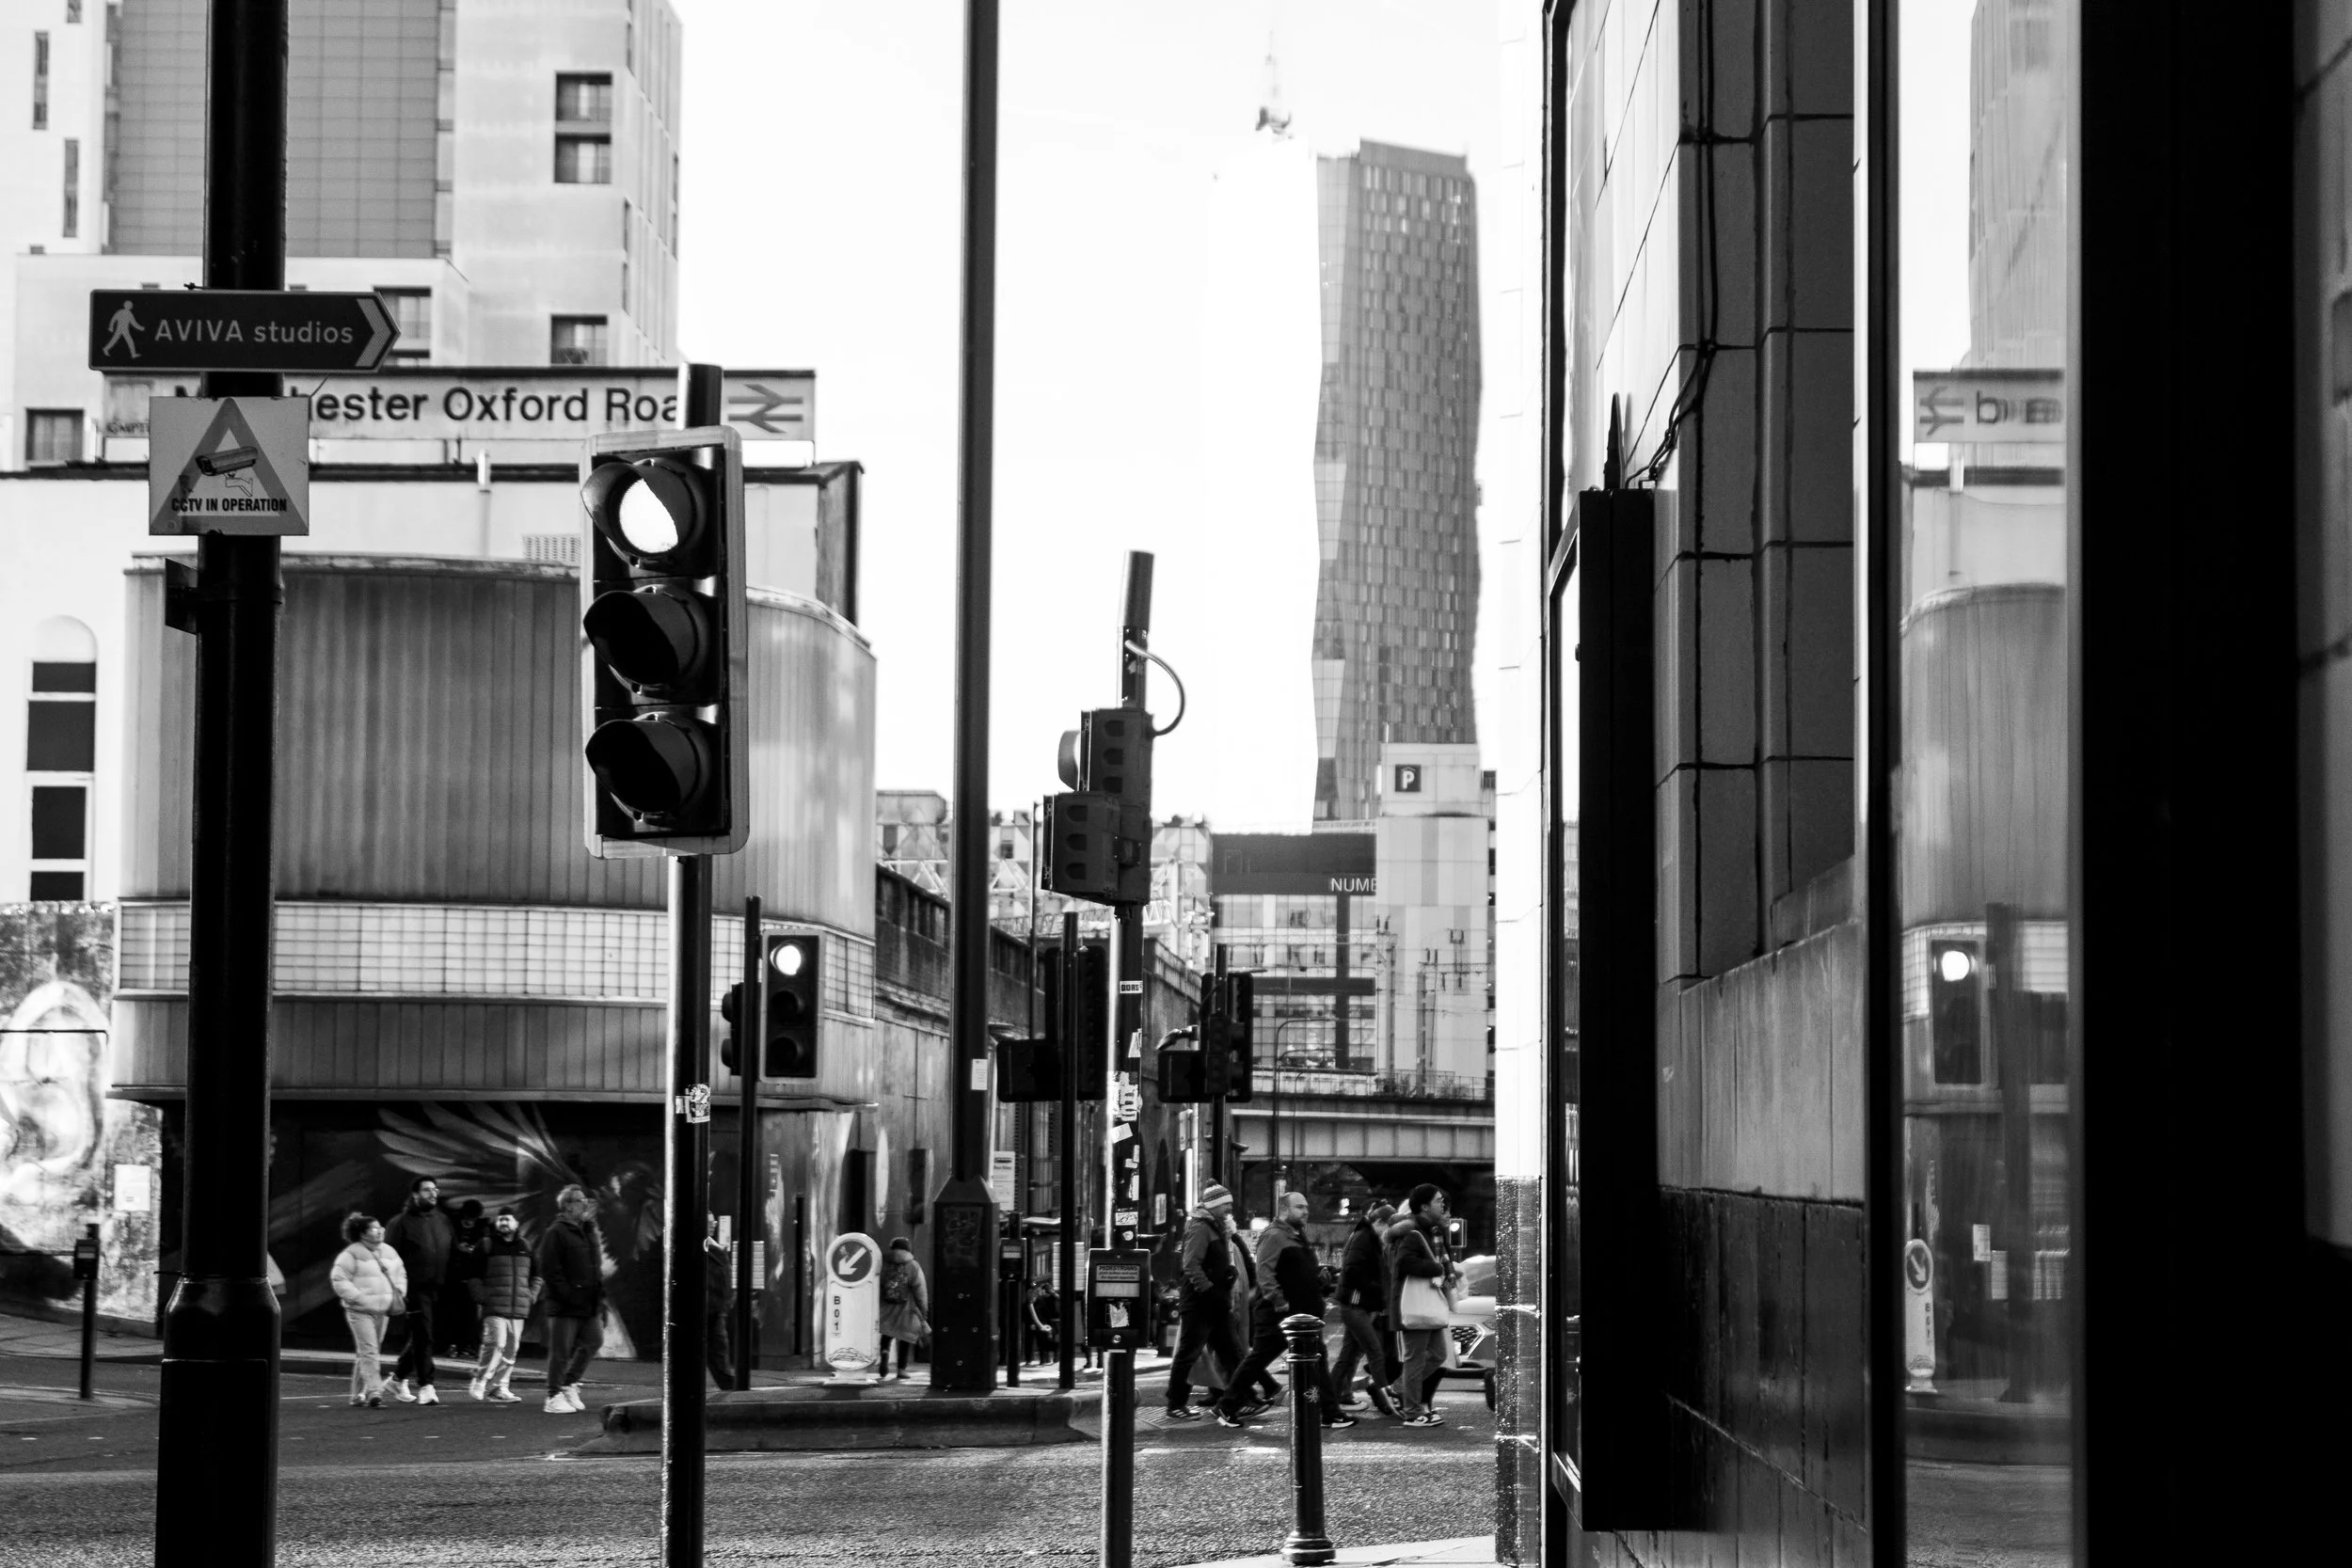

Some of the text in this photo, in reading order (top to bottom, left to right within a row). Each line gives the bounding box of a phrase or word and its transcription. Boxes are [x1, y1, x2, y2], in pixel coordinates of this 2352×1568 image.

[153, 319, 354, 344] AVIVA studios
[443, 387, 588, 421] Oxford
[606, 387, 677, 422] Roa
[171, 498, 288, 513] CCTV IN OPERATION
[1403, 770, 1415, 790] P
